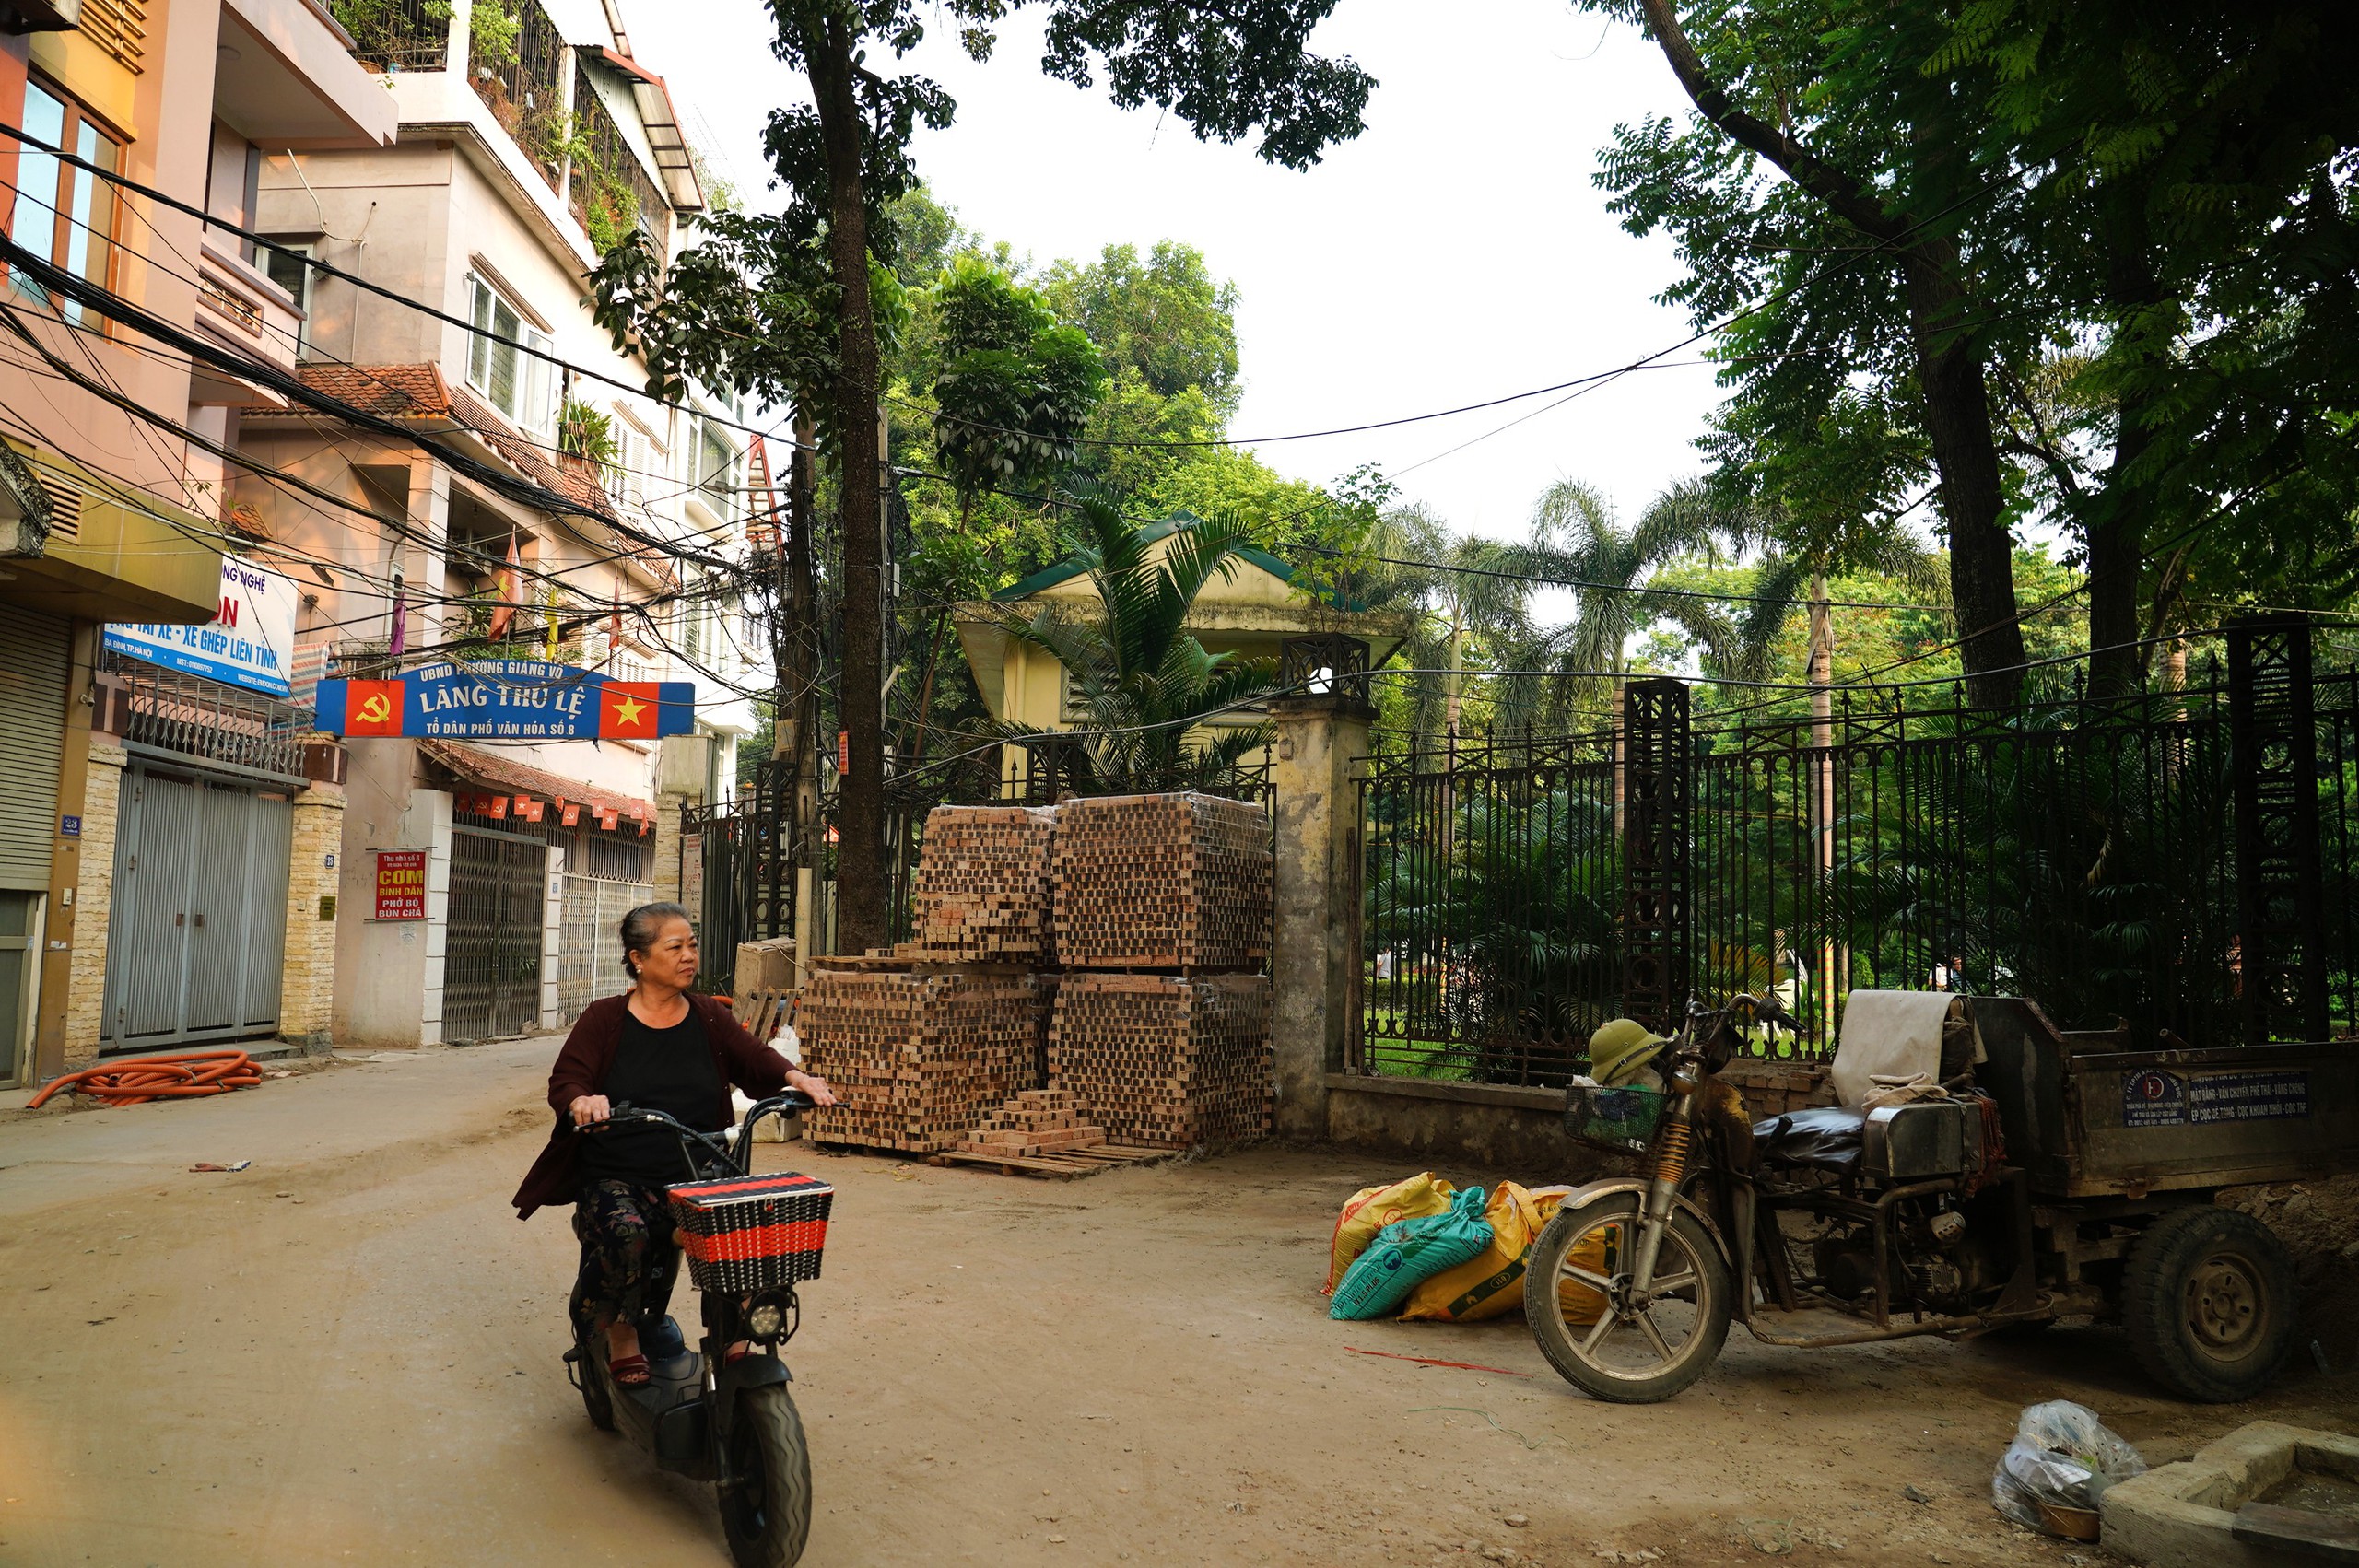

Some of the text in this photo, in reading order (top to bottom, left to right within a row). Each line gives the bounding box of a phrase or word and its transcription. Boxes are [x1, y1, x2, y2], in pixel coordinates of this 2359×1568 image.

[220, 564, 265, 595] NG NGHỆ
[104, 638, 112, 648] BA
[183, 625, 197, 648] XE
[200, 630, 228, 655] GHÉP
[230, 638, 252, 663] LIÊN
[256, 641, 277, 670] TỈNH
[420, 665, 452, 682] UBND
[508, 661, 546, 676] GIẢNG
[419, 681, 586, 720] LÀNG THỦ LỆ
[427, 717, 575, 735] TỔ DÂN PHỐ VĂN HÓA SỐ 8
[379, 869, 424, 885] CƠM
[405, 885, 423, 895] DÂN
[382, 897, 404, 907] PHỞ
[402, 907, 422, 917] CHẢ
